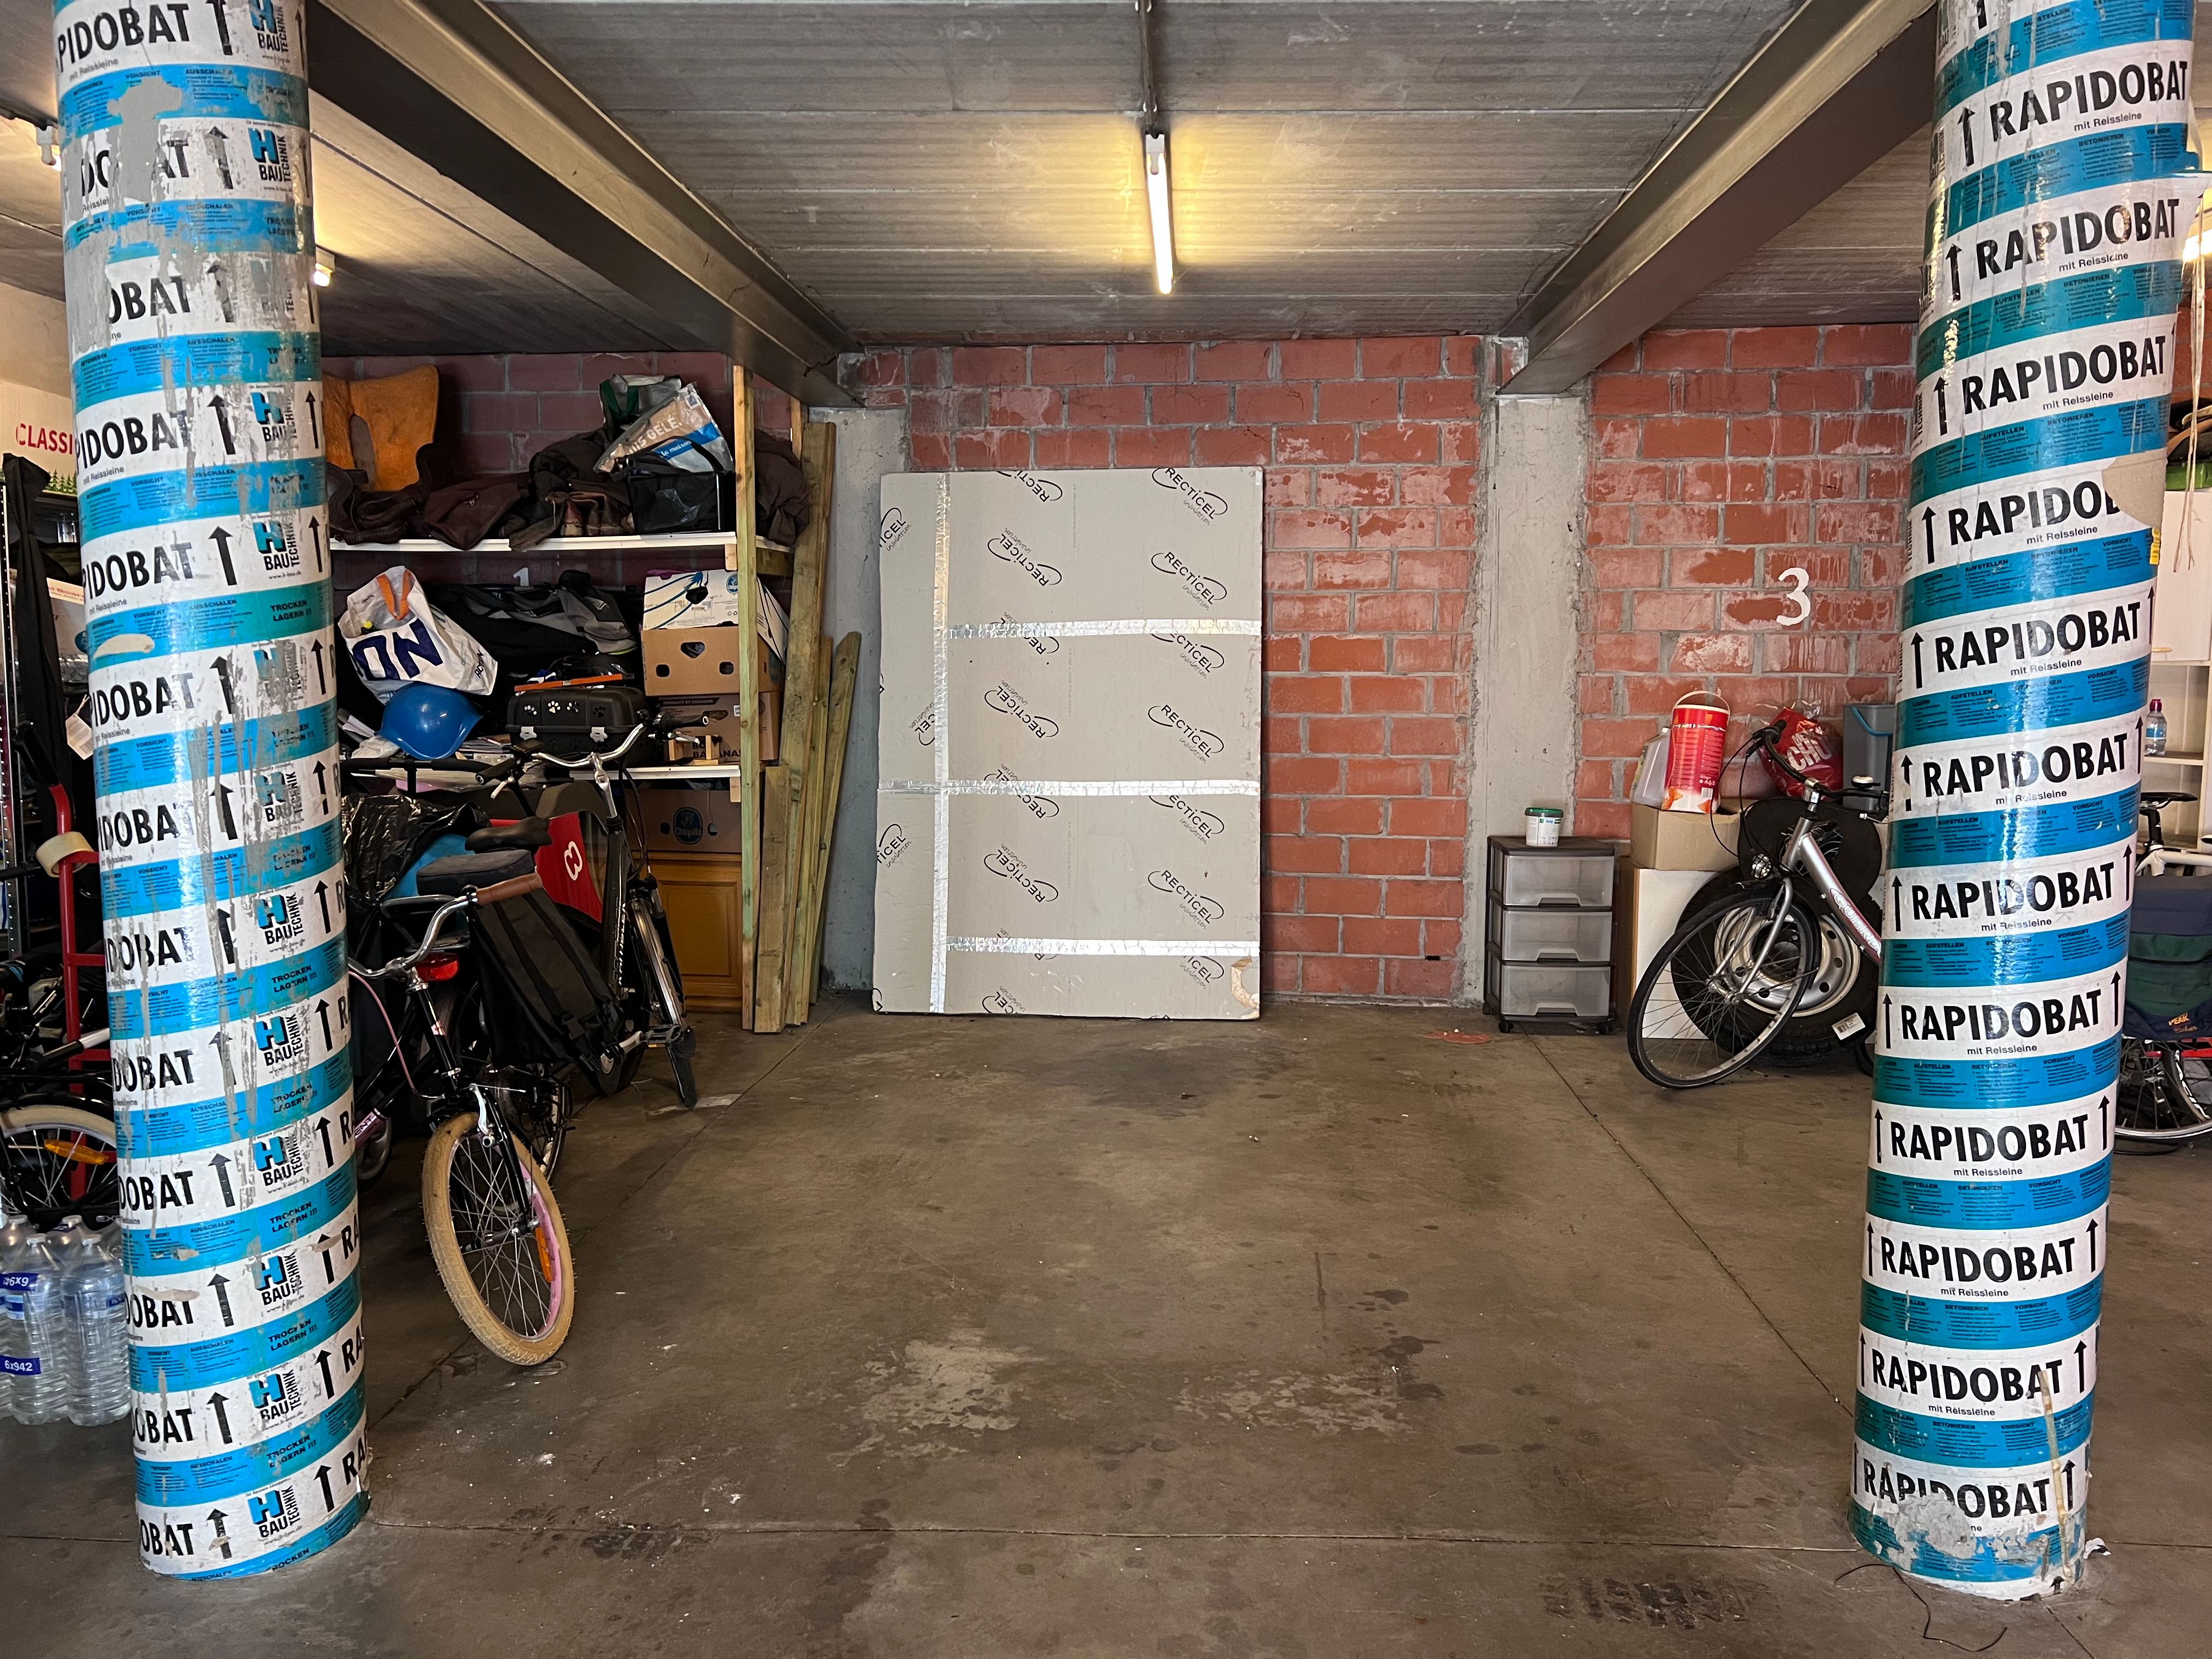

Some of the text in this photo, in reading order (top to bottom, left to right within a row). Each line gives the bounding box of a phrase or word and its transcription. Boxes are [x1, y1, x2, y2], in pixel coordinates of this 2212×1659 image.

[1989, 60, 2188, 143] RAPIDOBAT
[2074, 112, 2143, 132] mit Reissleine
[259, 165, 283, 182] BAU
[1976, 198, 2180, 280] RAPIDOBAT
[2058, 252, 2129, 273] mit Reissleine
[1961, 335, 2166, 415] RAPIDOBAT
[2042, 390, 2114, 410] mit Reissleine
[91, 466, 125, 481] Reissleine
[1165, 467, 1217, 521] RECTICEL
[287, 522, 301, 567] TECHNIK
[2026, 524, 2098, 545] mit Reissleine
[82, 542, 194, 599] IDOBAT
[264, 553, 290, 571] BAU
[999, 533, 1050, 588] RECTICEL
[513, 567, 529, 586] 1
[1163, 551, 1217, 605] RECTICEL
[270, 600, 308, 612] TROCKEN
[1776, 566, 1811, 627] 3
[273, 610, 304, 622] LAGERN
[1935, 601, 2141, 674] RAPIDOBAT
[2010, 658, 2082, 677] mit Reissleine
[996, 685, 1047, 740] RECTICEL
[1160, 703, 1213, 758] RECTICEL
[1923, 732, 2129, 798] RAPIDOBAT
[996, 848, 1047, 904] RECTICEL
[1160, 868, 1212, 925] RECTICEL
[1911, 861, 2115, 921] RAPIDOBAT
[286, 895, 304, 937] TECHNIK
[1980, 918, 2053, 933] mit Reissleine
[264, 930, 293, 945] BAU
[2057, 928, 2090, 939] VORSICHT
[1900, 989, 2102, 1041] RAPIDOBAT
[285, 1014, 304, 1057] TECHNIK
[263, 1049, 293, 1066] BAU
[1966, 1043, 2038, 1056] mit Reissleine
[2042, 1054, 2076, 1065] VORSICHT
[1890, 1114, 2089, 1163] RAPIDOBAT
[262, 1170, 291, 1187] BAU
[1954, 1166, 2023, 1176] mit Reissleine
[2029, 1178, 2062, 1189] VORSICHT
[269, 1201, 312, 1224] TROCKEN
[284, 1250, 303, 1294] TECHNIK
[1880, 1237, 2076, 1283] RAPIDOBAT
[261, 1289, 291, 1306] BAU
[1940, 1287, 2009, 1297] mit Reissleine
[2014, 1301, 2048, 1311] VORSICHT
[270, 1330, 308, 1351] LAGERN
[1871, 1348, 2063, 1402] RAPIDOBAT
[283, 1369, 302, 1412] TECHNIK
[259, 1401, 289, 1421] BAU
[1928, 1404, 1996, 1417] mit Reissleine
[266, 1434, 311, 1459] TROCKEN
[1863, 1458, 2051, 1519] RAPIDOBAT
[247, 1489, 284, 1525] H
[282, 1485, 302, 1526] TECHNIK
[258, 1517, 289, 1538] BAU
